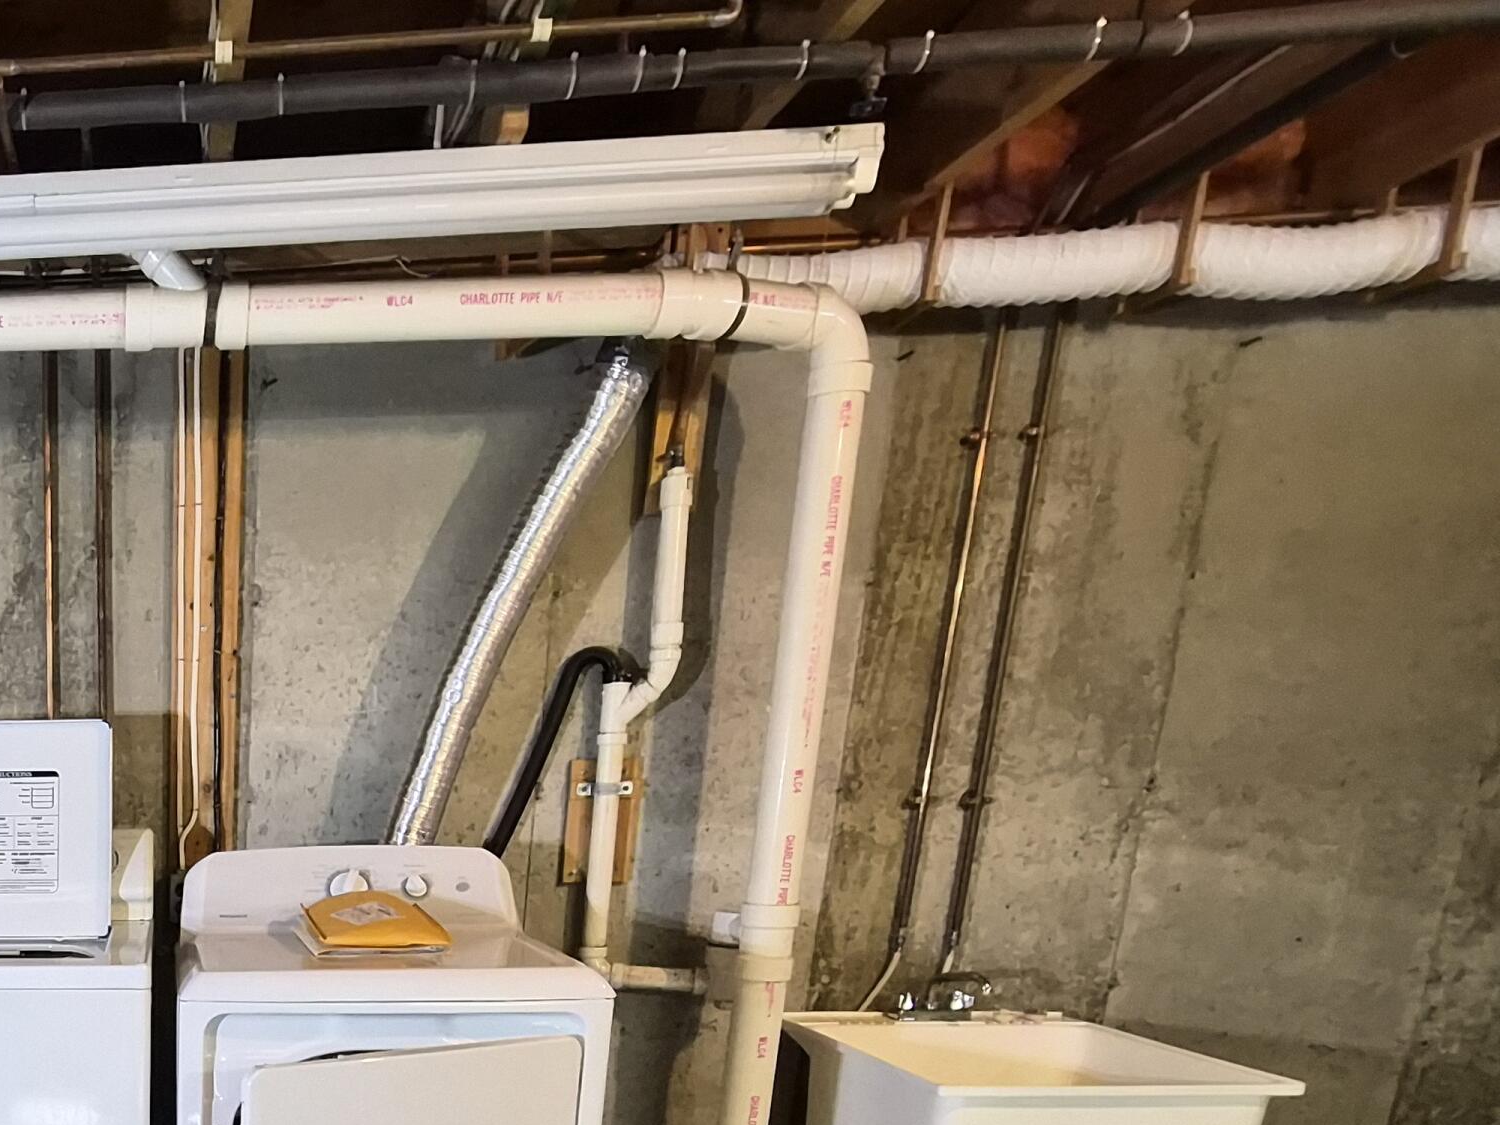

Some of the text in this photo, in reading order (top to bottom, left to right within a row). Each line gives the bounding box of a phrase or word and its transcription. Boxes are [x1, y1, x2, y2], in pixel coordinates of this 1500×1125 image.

[459, 292, 515, 305] CHARLOTTE
[520, 291, 540, 304] PIPE
[779, 834, 796, 884] CHARLOTTE
